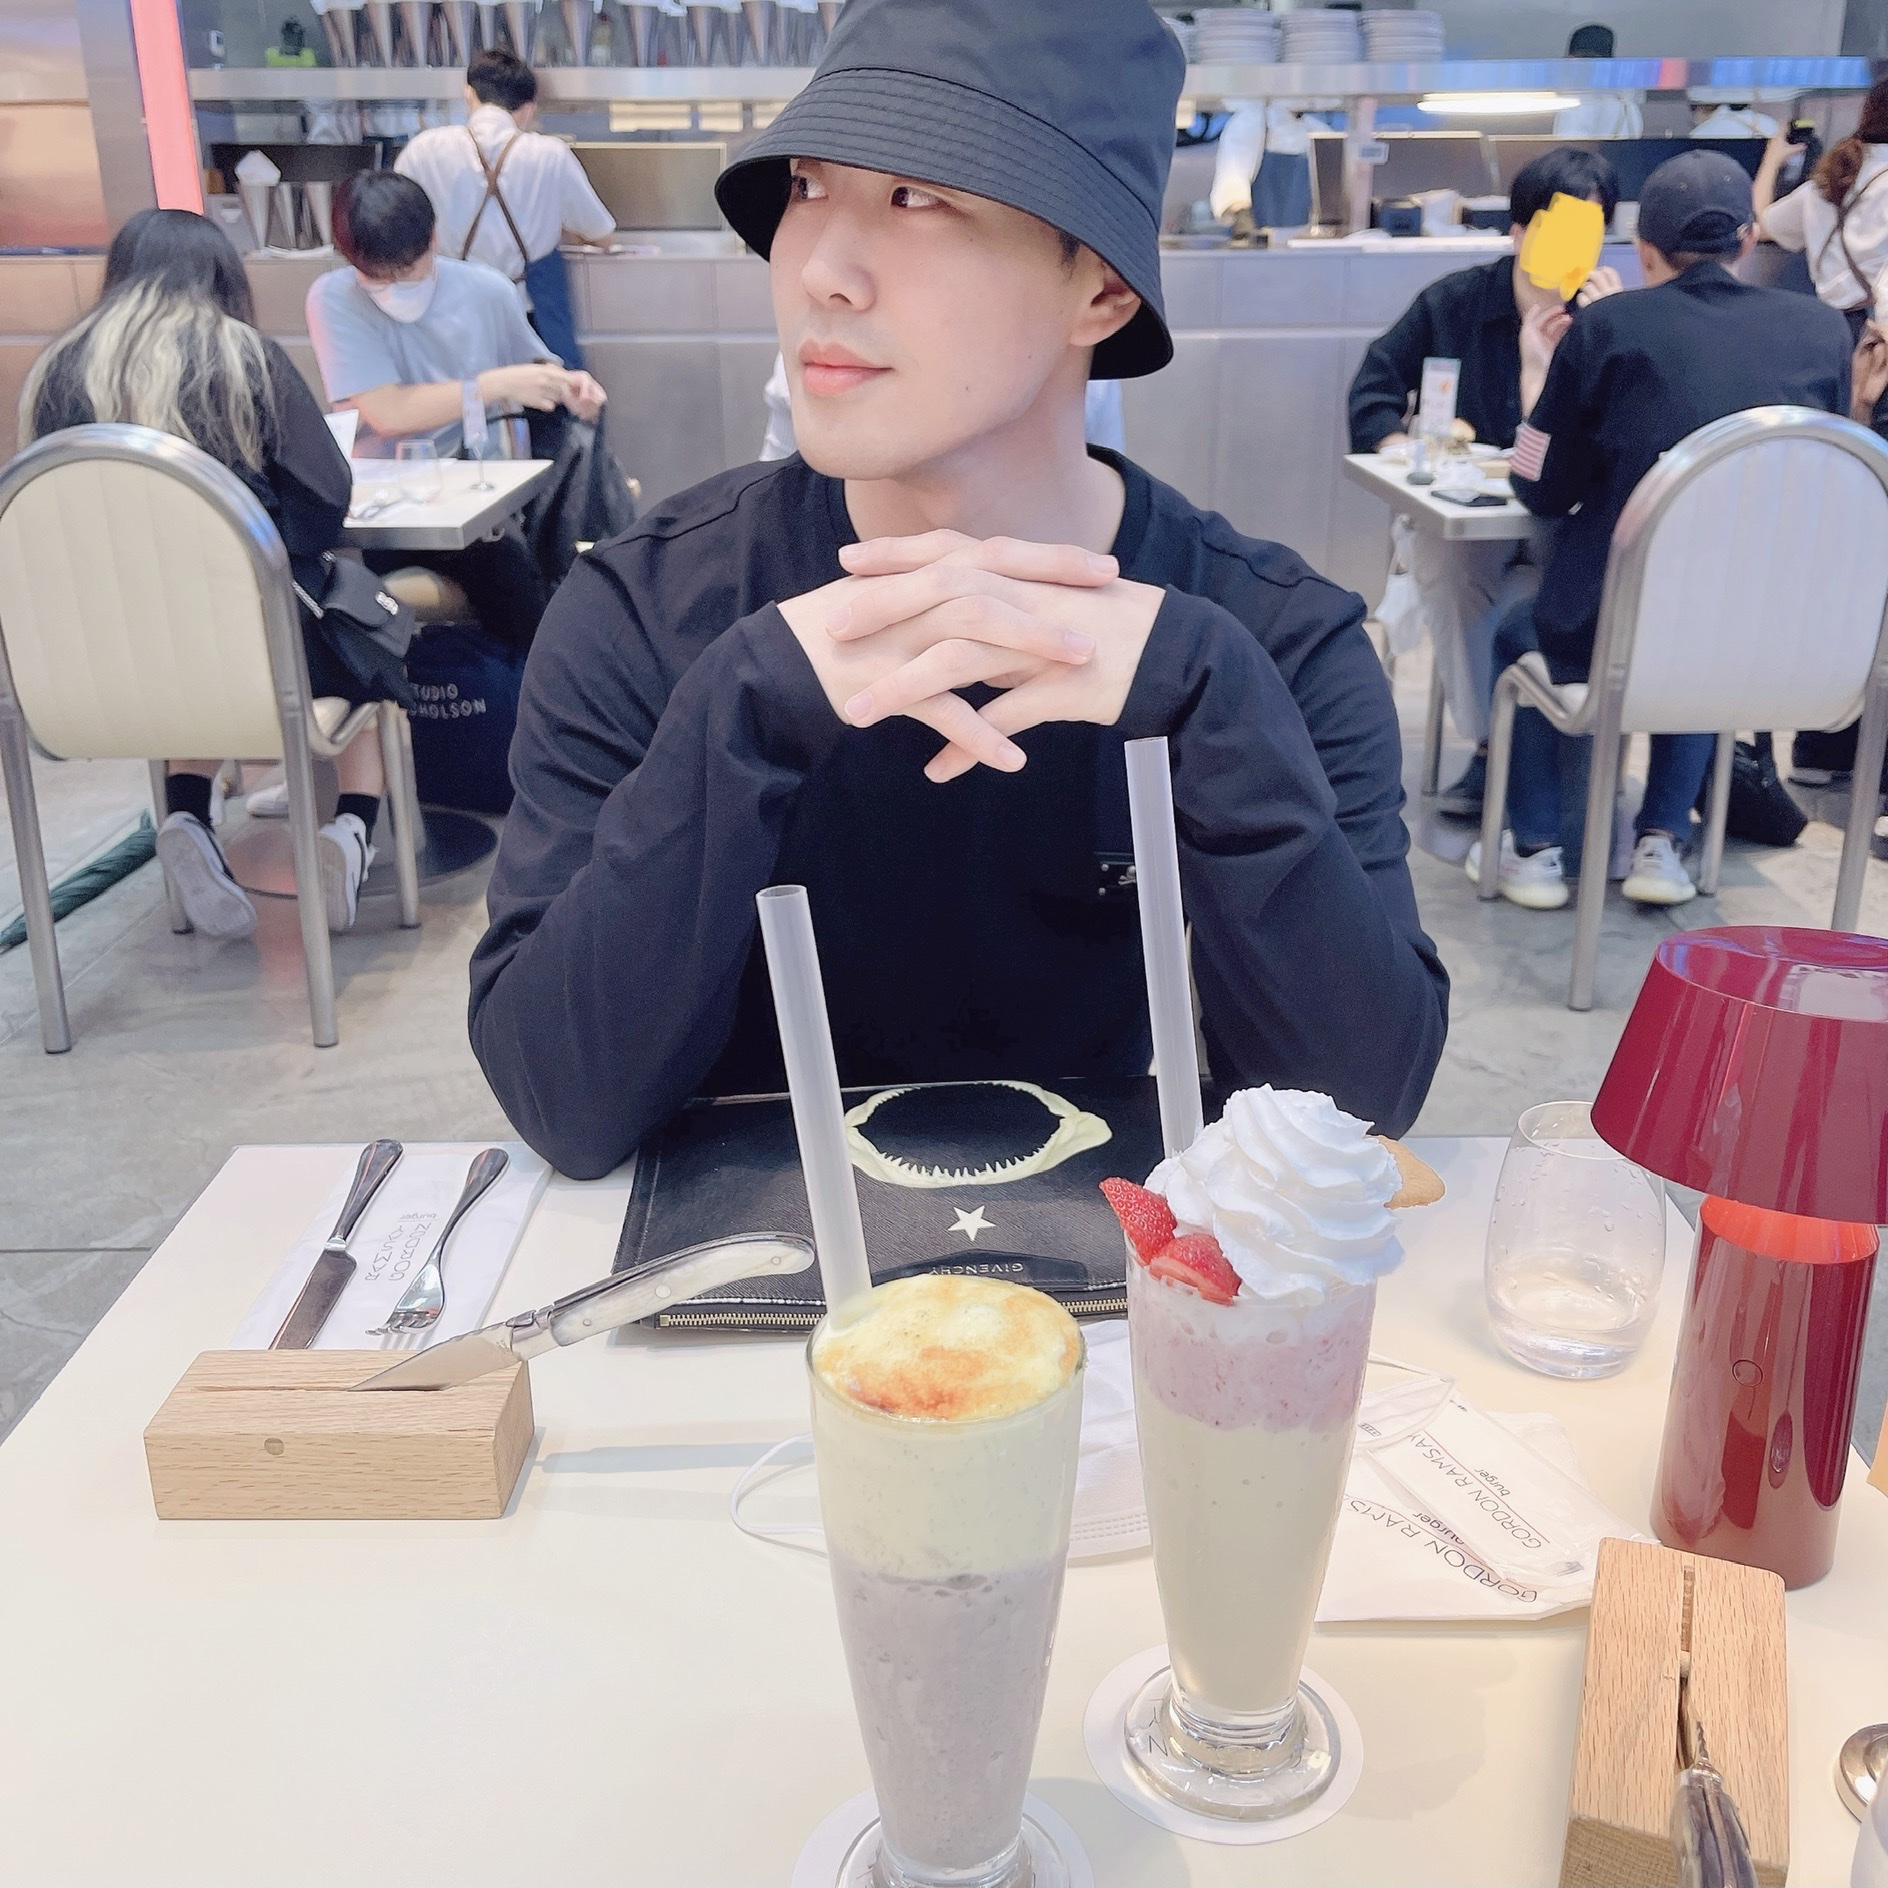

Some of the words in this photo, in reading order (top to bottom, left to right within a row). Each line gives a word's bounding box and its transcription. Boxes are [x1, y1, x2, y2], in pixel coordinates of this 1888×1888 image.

[409, 683, 458, 701] TUDIO
[409, 698, 487, 720] HOLSON
[400, 1212, 437, 1220] burger
[364, 1225, 404, 1281] RAMSAY
[388, 1222, 432, 1281] GORDON
[929, 1262, 1024, 1275] GIVENCHY
[1407, 1433, 1474, 1488] RAMSAY
[1474, 1468, 1511, 1497] burger
[1347, 1499, 1421, 1538] RAMS
[1467, 1489, 1542, 1549] GORDON
[1424, 1540, 1538, 1603] GORDON
